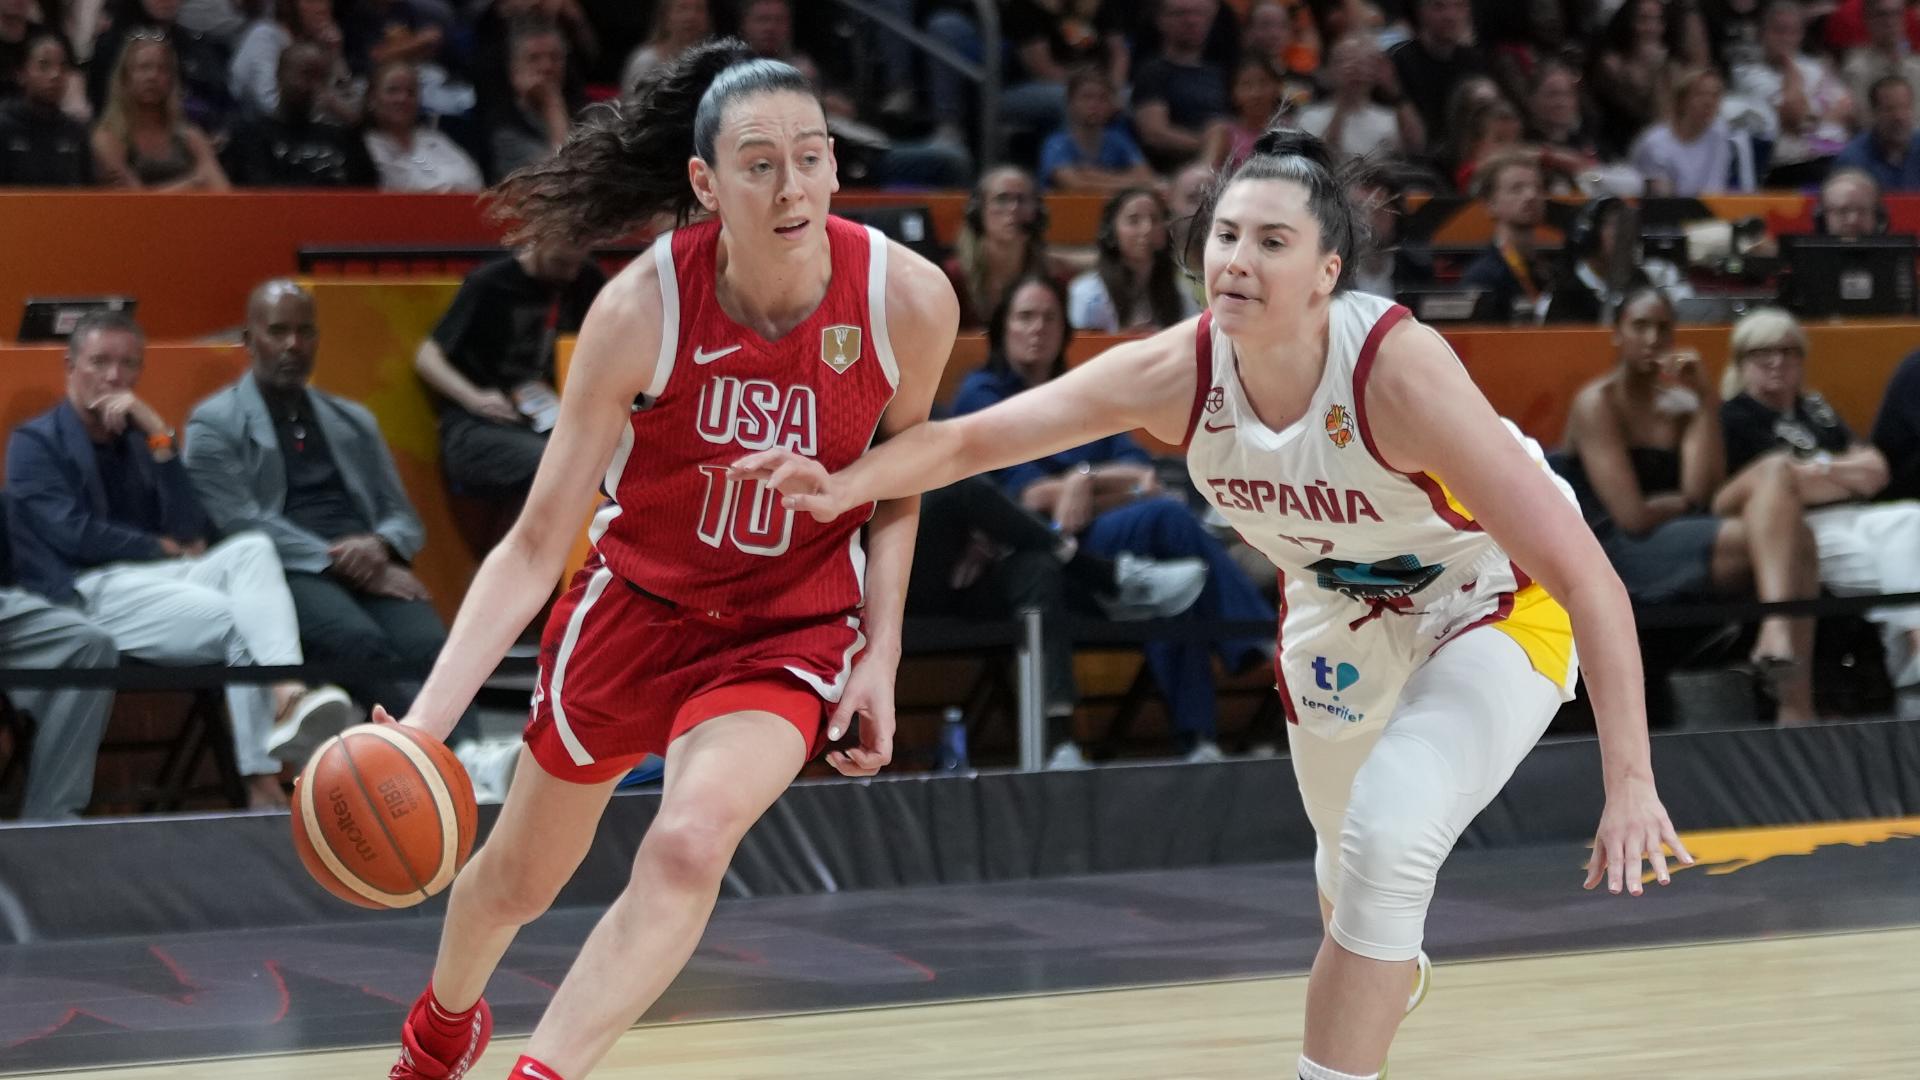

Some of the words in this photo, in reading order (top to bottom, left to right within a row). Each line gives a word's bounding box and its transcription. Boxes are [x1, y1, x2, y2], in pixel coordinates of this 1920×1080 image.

[696, 376, 818, 457] USA
[697, 464, 796, 557] 10
[1207, 478, 1385, 524] ESPAÑA
[329, 786, 378, 861] molten
[378, 777, 411, 820] FIBA
